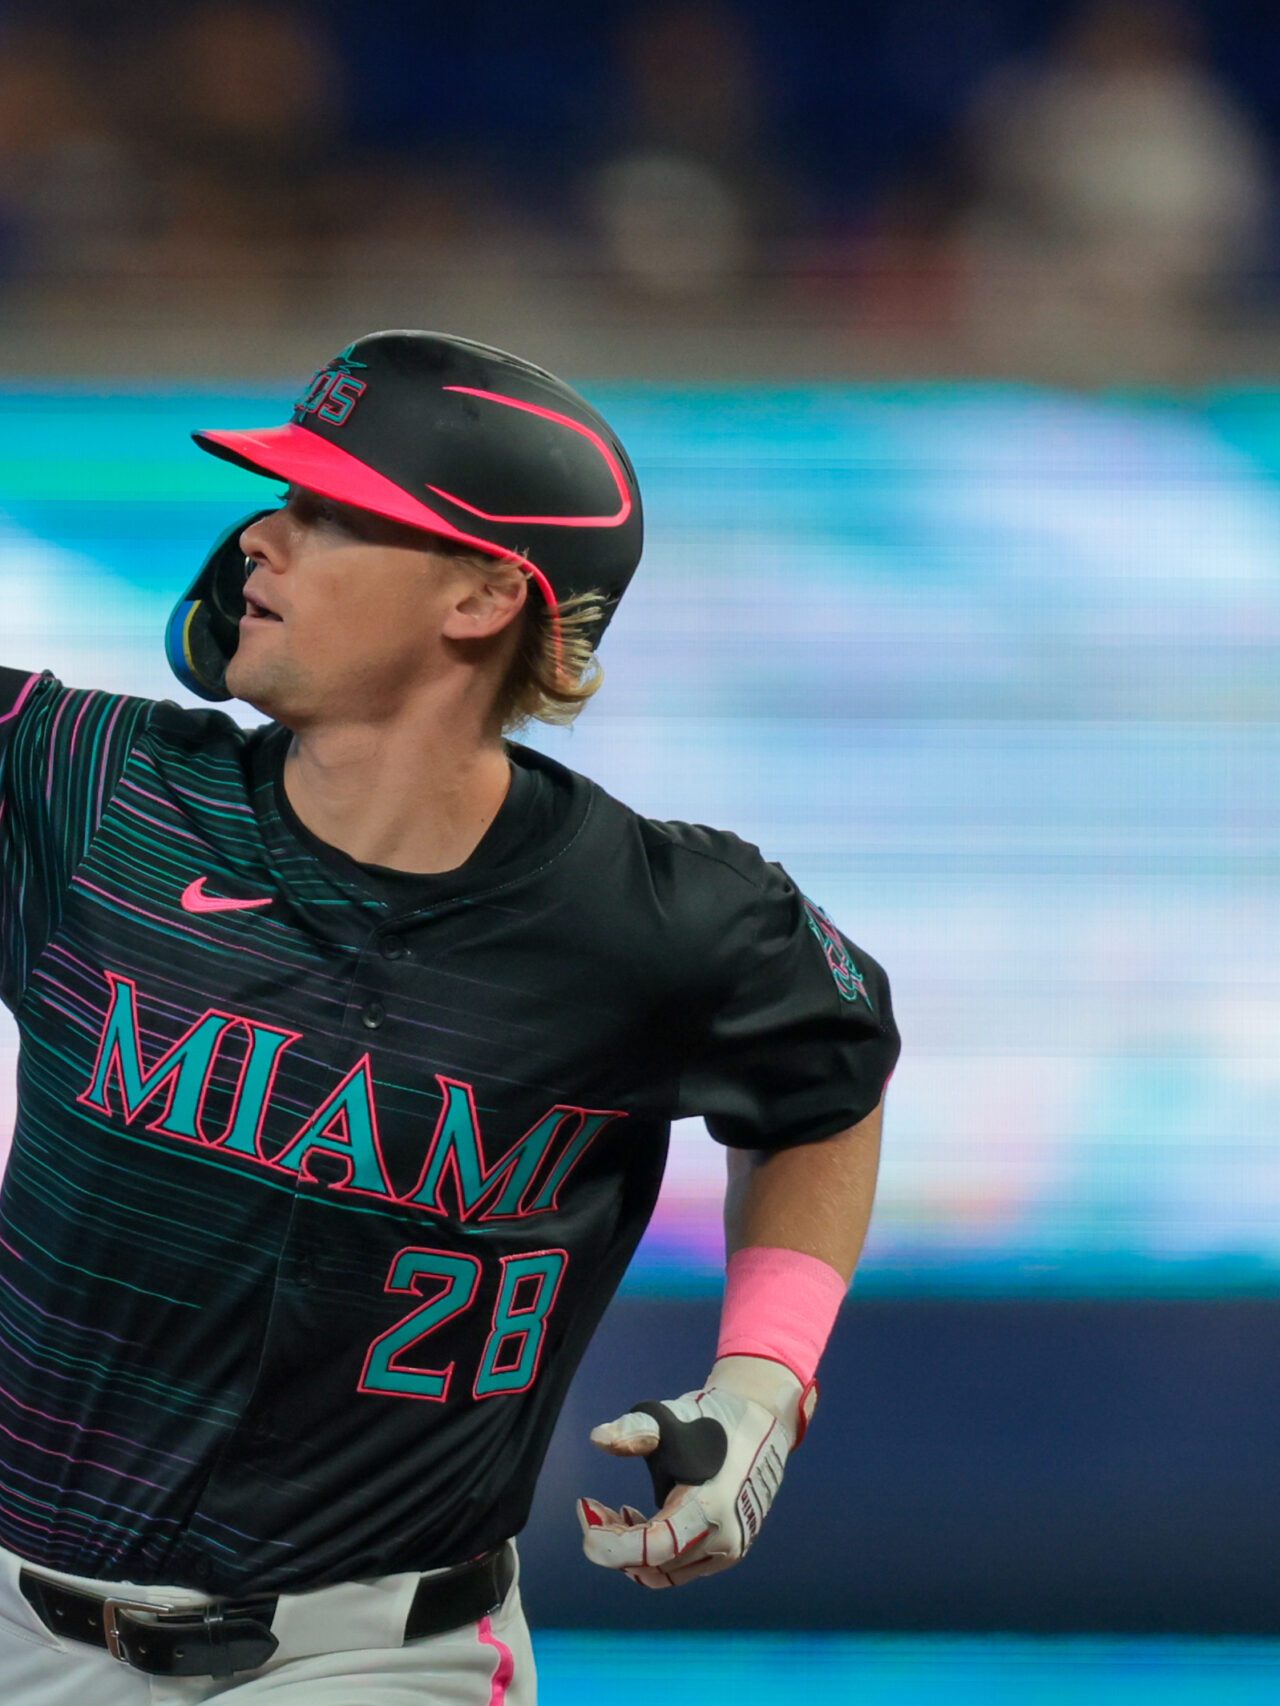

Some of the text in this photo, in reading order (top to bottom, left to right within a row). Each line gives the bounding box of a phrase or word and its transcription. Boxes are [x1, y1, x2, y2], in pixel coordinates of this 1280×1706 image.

[295, 369, 368, 427] 05
[76, 969, 629, 1223] MIAMI
[356, 1246, 569, 1403] 28
